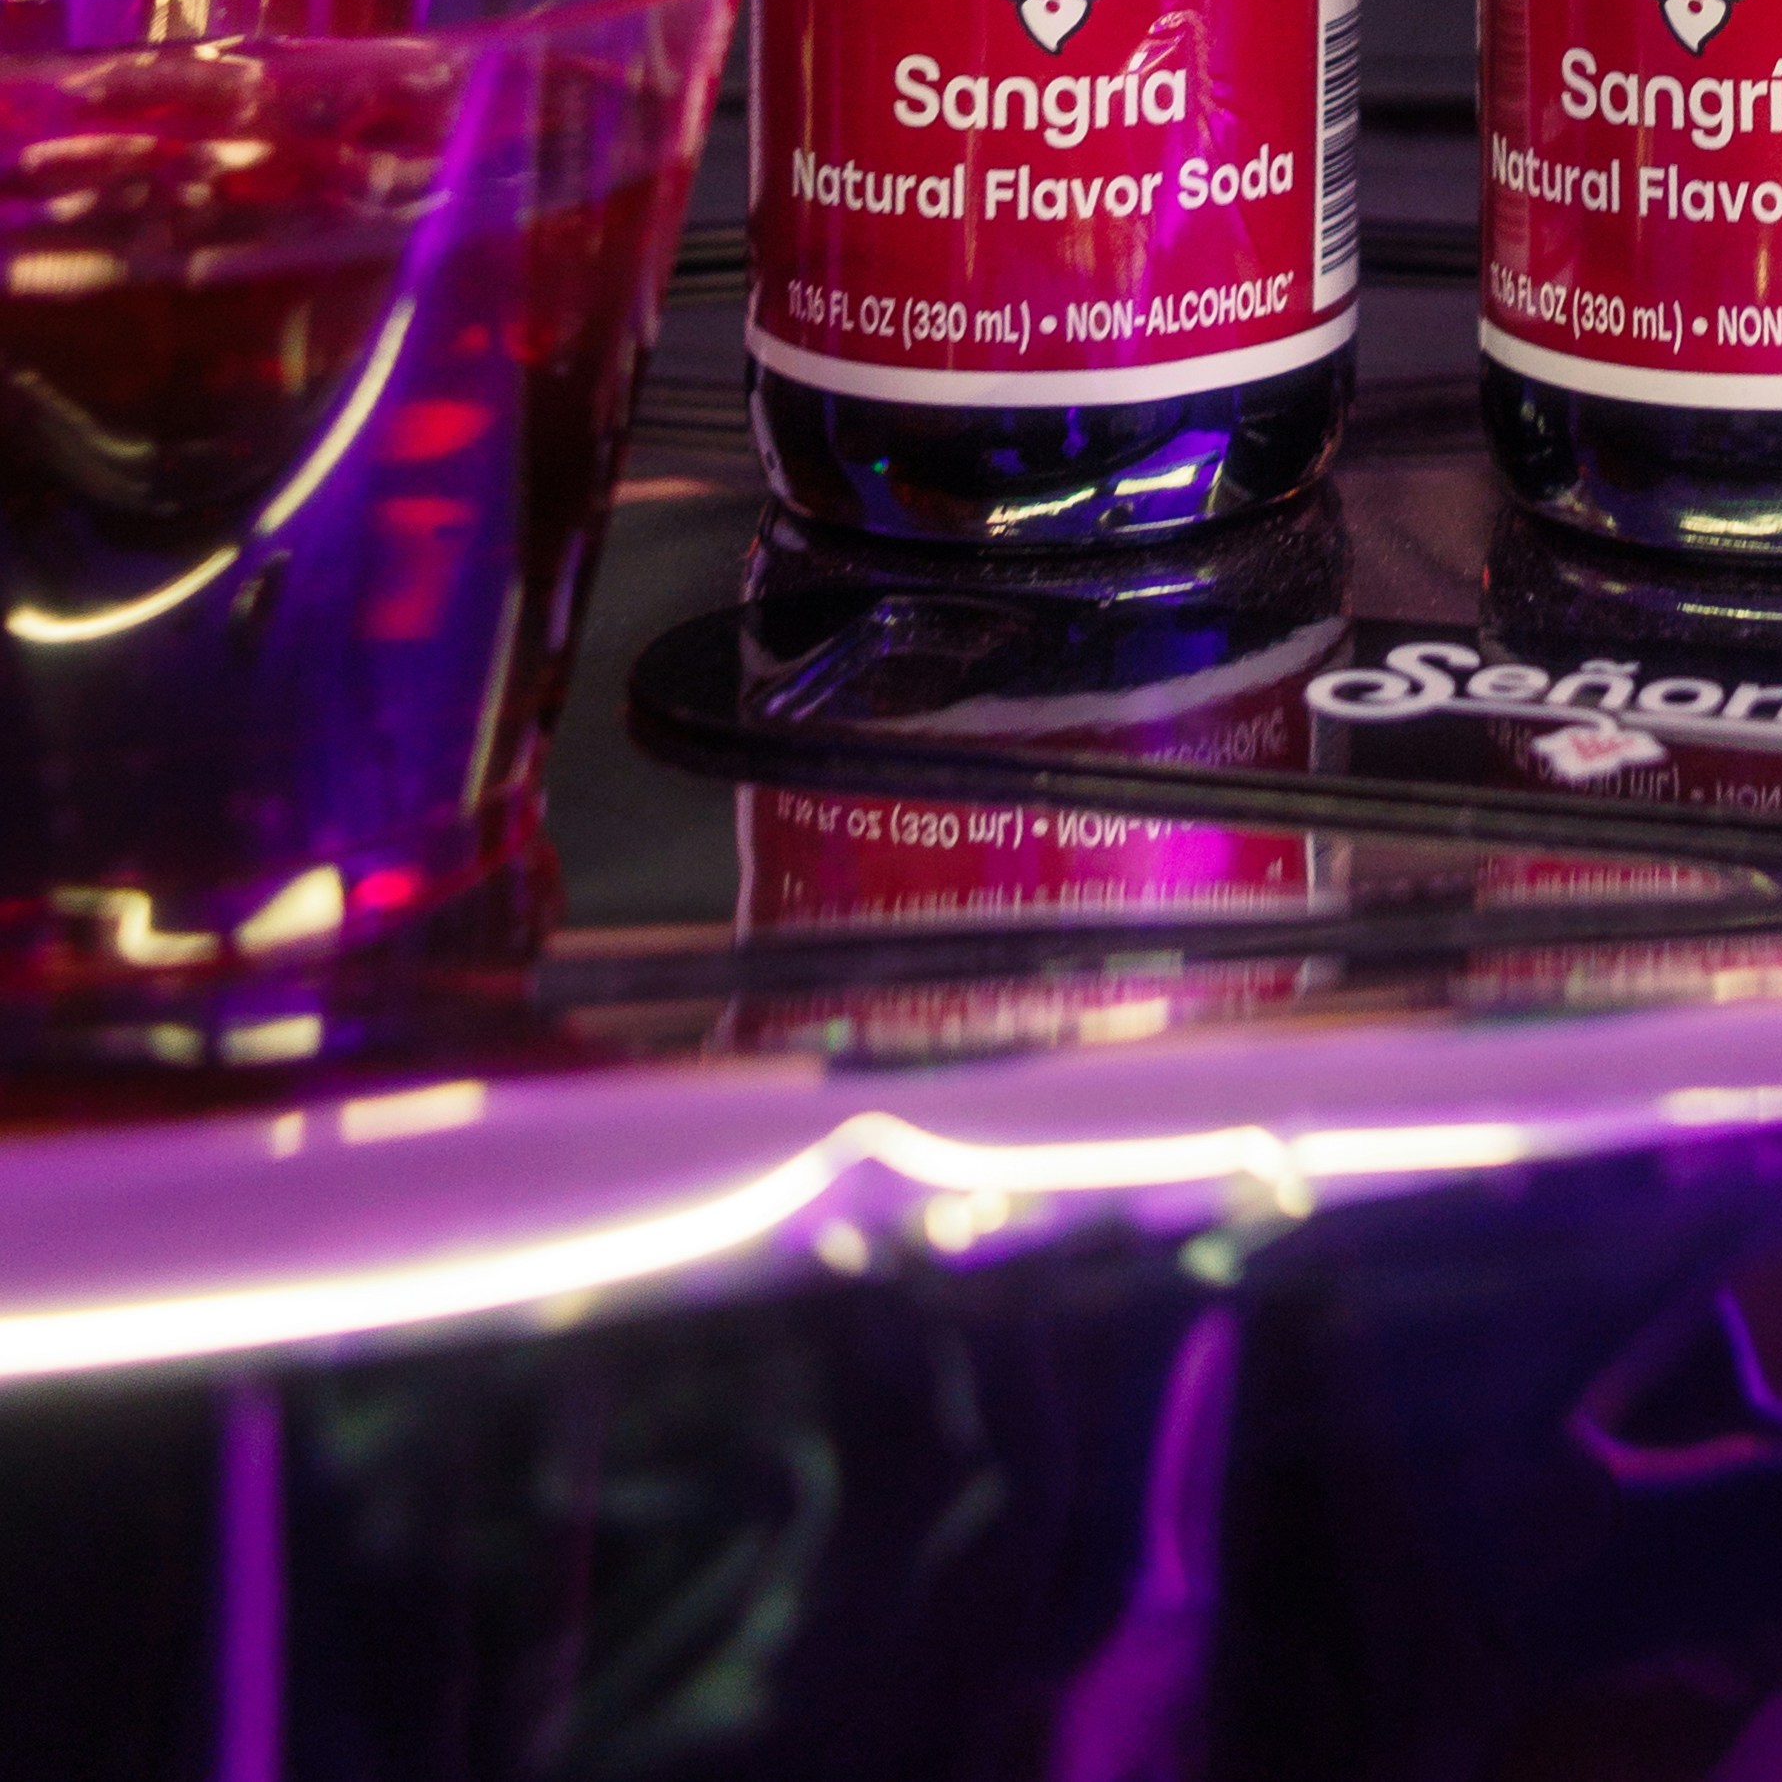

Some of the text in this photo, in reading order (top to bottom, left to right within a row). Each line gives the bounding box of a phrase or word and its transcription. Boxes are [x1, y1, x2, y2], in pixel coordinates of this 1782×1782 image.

[893, 51, 1188, 149] Sangría
[791, 143, 1296, 223] Natural Flavor Soda
[1491, 130, 1622, 215] Natural
[829, 289, 855, 331] FL
[859, 295, 896, 337] OZ
[902, 296, 968, 352] (330
[973, 299, 1030, 355] mL)
[1517, 273, 1537, 317] FL
[1540, 281, 1567, 326] OZ
[1571, 286, 1626, 341] (330
[1631, 299, 1683, 355] mL)
